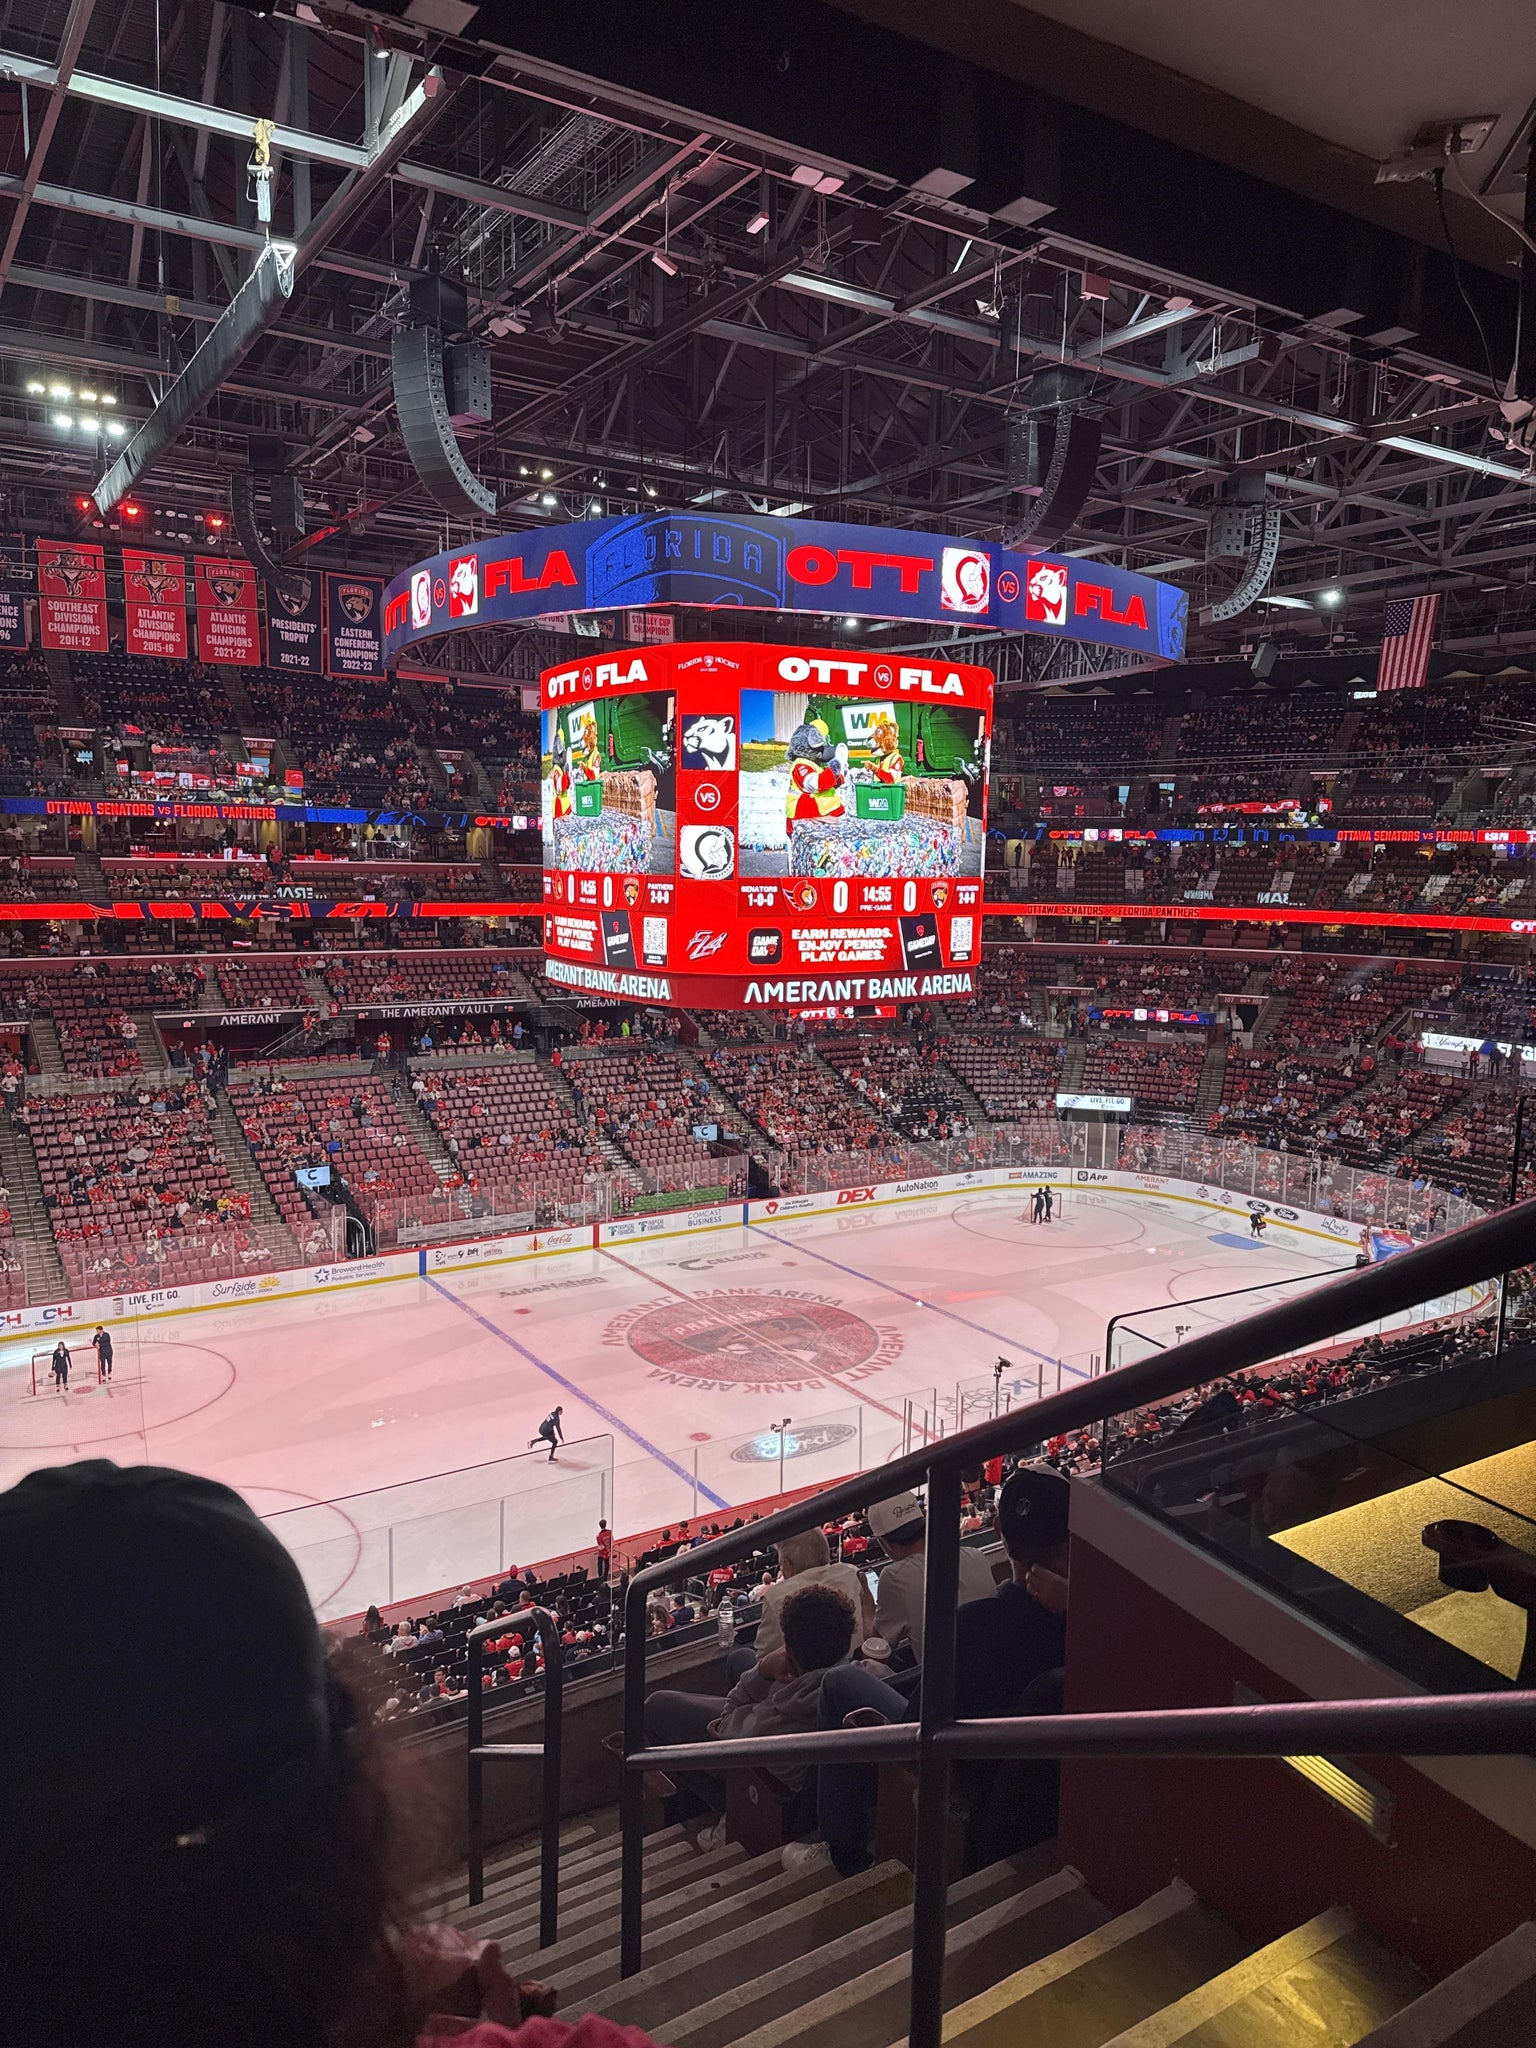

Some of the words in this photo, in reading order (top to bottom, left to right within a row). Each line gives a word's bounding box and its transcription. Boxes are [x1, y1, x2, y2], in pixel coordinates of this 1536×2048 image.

[606, 529, 762, 581] FLORIDA
[384, 590, 409, 636] OTT
[485, 550, 578, 598] FLA
[786, 545, 934, 593] OTT
[1002, 581, 1015, 593] VS
[1074, 581, 1148, 629] FLA
[48, 601, 98, 614] SOUTHEAST
[54, 612, 93, 624] DIVISION
[137, 608, 175, 621] ATLANTIC
[210, 612, 246, 624] ATLANTIC
[659, 616, 671, 626] CUP
[48, 622, 100, 635] CHAMPIONS
[139, 619, 174, 631] DIVISION
[212, 624, 246, 636] DIVISION
[271, 618, 317, 633] PRESIDENTS'
[133, 628, 180, 642] CHAMPIONS
[280, 631, 309, 644] TROPHY
[341, 627, 372, 639] EASTERN
[60, 634, 90, 646] 2011-12
[206, 635, 252, 648] CHAMPIONS
[334, 637, 379, 650] CONFERENCE
[143, 641, 174, 653] 2015-16
[214, 647, 246, 659] 2021-22
[280, 653, 310, 666] 2021-22
[335, 648, 378, 660] CHAMPIONS
[343, 660, 373, 671] 2022-23
[678, 656, 703, 670] FLORIDA
[715, 656, 740, 669] HOCKEY
[548, 671, 579, 698] OTT
[596, 658, 648, 687] FLA
[778, 657, 867, 686] OTT
[899, 668, 964, 696] FLA
[850, 711, 888, 729] WM
[700, 792, 716, 802] VS
[46, 800, 93, 815] OTTAWA
[96, 801, 154, 816] SENATORS
[173, 803, 219, 818] FLORIDA
[222, 805, 276, 820] PANTHERS
[475, 816, 511, 827] OTT
[1049, 830, 1083, 839] OTT
[1124, 830, 1157, 839] FLA
[1337, 831, 1371, 841] OTTAWA
[1374, 831, 1420, 841] SENATORS
[1436, 831, 1474, 842] FLORIDA
[568, 874, 575, 904] 0
[603, 876, 613, 907] 0
[647, 883, 674, 891] PANTHERS
[650, 890, 670, 904] 2-0-0
[749, 893, 774, 907] 1-0-0
[833, 881, 848, 913] 0
[863, 885, 892, 903] 14:55
[903, 881, 917, 912] 0
[1027, 905, 1060, 914] OTTAWA
[1061, 905, 1104, 915] SENATORS
[1118, 906, 1153, 916] FLORIDA
[1155, 907, 1200, 918] PANTHERS
[791, 928, 829, 940] EARN
[830, 927, 893, 939] REWARDS.
[752, 936, 779, 946] GAME
[798, 939, 841, 951] ENJOY
[843, 939, 887, 950] PERKS.
[751, 946, 768, 957] DAY
[801, 950, 832, 962] PLAY
[833, 949, 884, 961] GAMES.
[585, 968, 619, 992] BANK
[618, 973, 671, 1000] ARENA
[744, 979, 865, 1004] AMERANT
[867, 976, 918, 998] BANK
[920, 972, 972, 993] ARENA
[381, 1008, 401, 1019] THE
[403, 1006, 456, 1018] AMERANT
[459, 1004, 494, 1015] VAULT
[800, 1009, 826, 1019] OTT
[1170, 1012, 1199, 1022] FLA
[220, 1013, 281, 1026] AMERANT
[12, 1025, 26, 1034] 133
[1022, 1171, 1058, 1179] AMAZING
[1136, 1174, 1169, 1185] AMERANT
[895, 1180, 939, 1194] AutoNation
[837, 1187, 878, 1205] DEX
[1251, 1202, 1268, 1212] Ford
[687, 1209, 722, 1220] COMCAST
[687, 1215, 722, 1227] BUSINESS
[1277, 1210, 1296, 1219] Ford
[707, 1251, 770, 1265] CELSIUS
[331, 1265, 362, 1275] Broward
[362, 1261, 385, 1271] Health
[212, 1280, 257, 1297] Surfside
[500, 1276, 608, 1299] AutoNation
[128, 1295, 149, 1305] LIVE.
[151, 1293, 166, 1302] FIT.
[166, 1290, 180, 1299] GO.
[42, 1305, 73, 1320] CH
[602, 1295, 673, 1346] AMERANT
[692, 1288, 761, 1298] BANK
[766, 1289, 843, 1307] ARENA
[844, 1325, 904, 1381] AMERANT
[648, 1367, 735, 1392] ARENA
[742, 1380, 826, 1393] BANK
